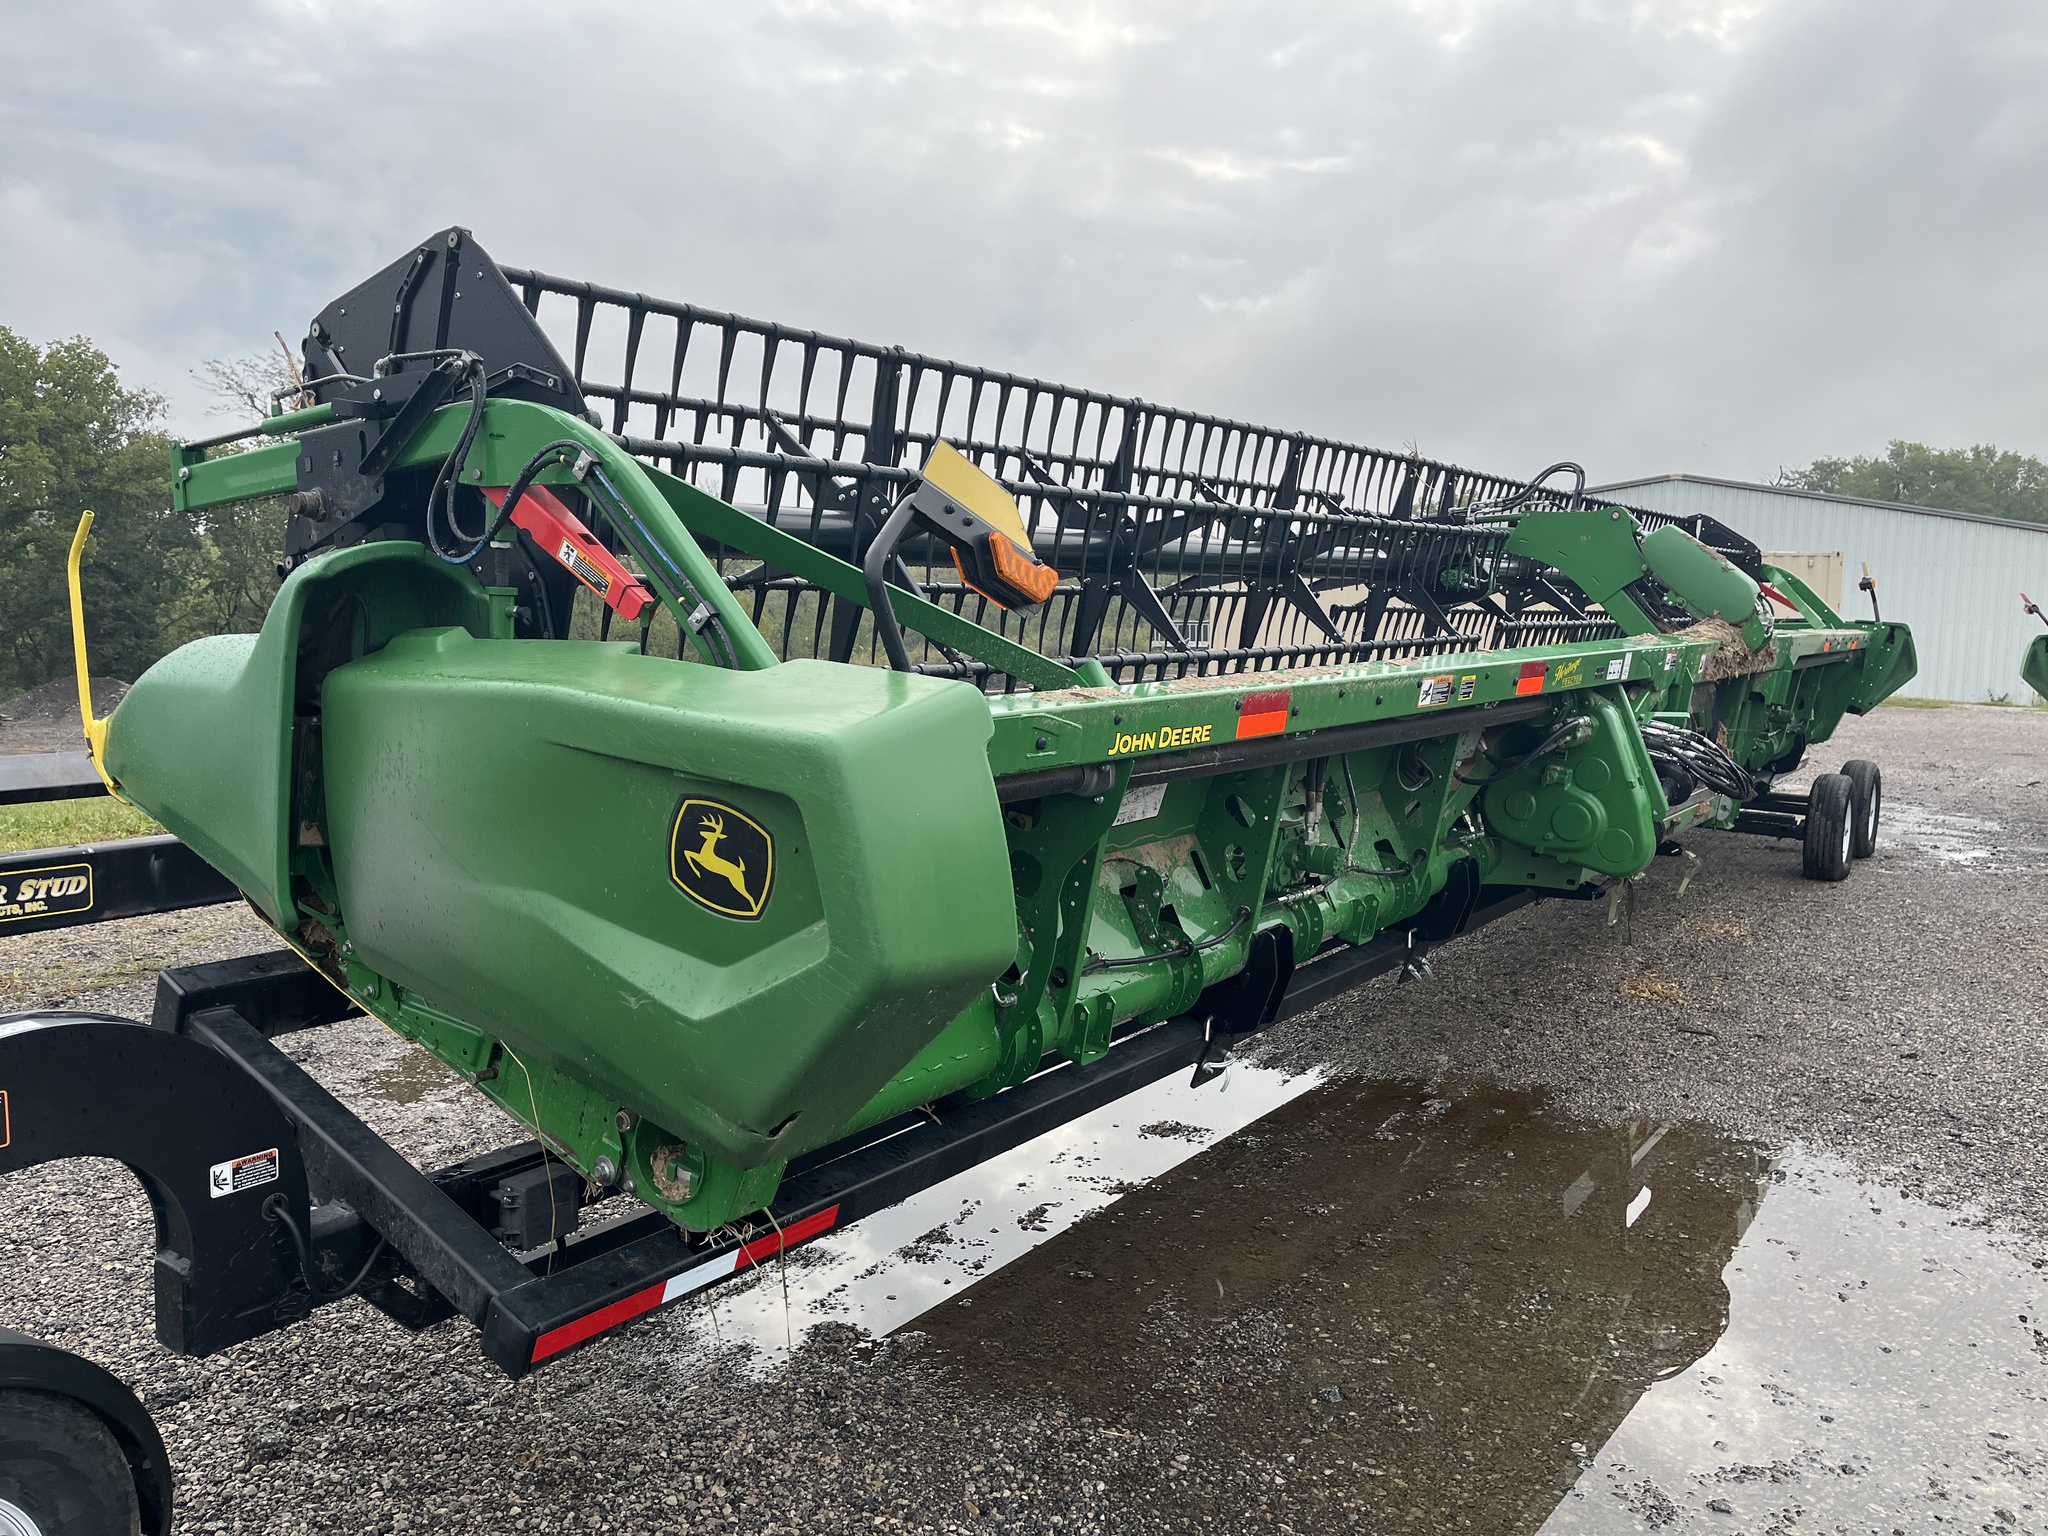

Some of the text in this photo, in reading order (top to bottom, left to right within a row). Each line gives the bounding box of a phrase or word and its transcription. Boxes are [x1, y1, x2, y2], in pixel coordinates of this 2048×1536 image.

[587, 558, 607, 578] WARNING
[1107, 724, 1213, 756] JOHN DEERE
[16, 875, 88, 902] STUD
[24, 900, 48, 913] INC.
[241, 1151, 273, 1165] WARNING
